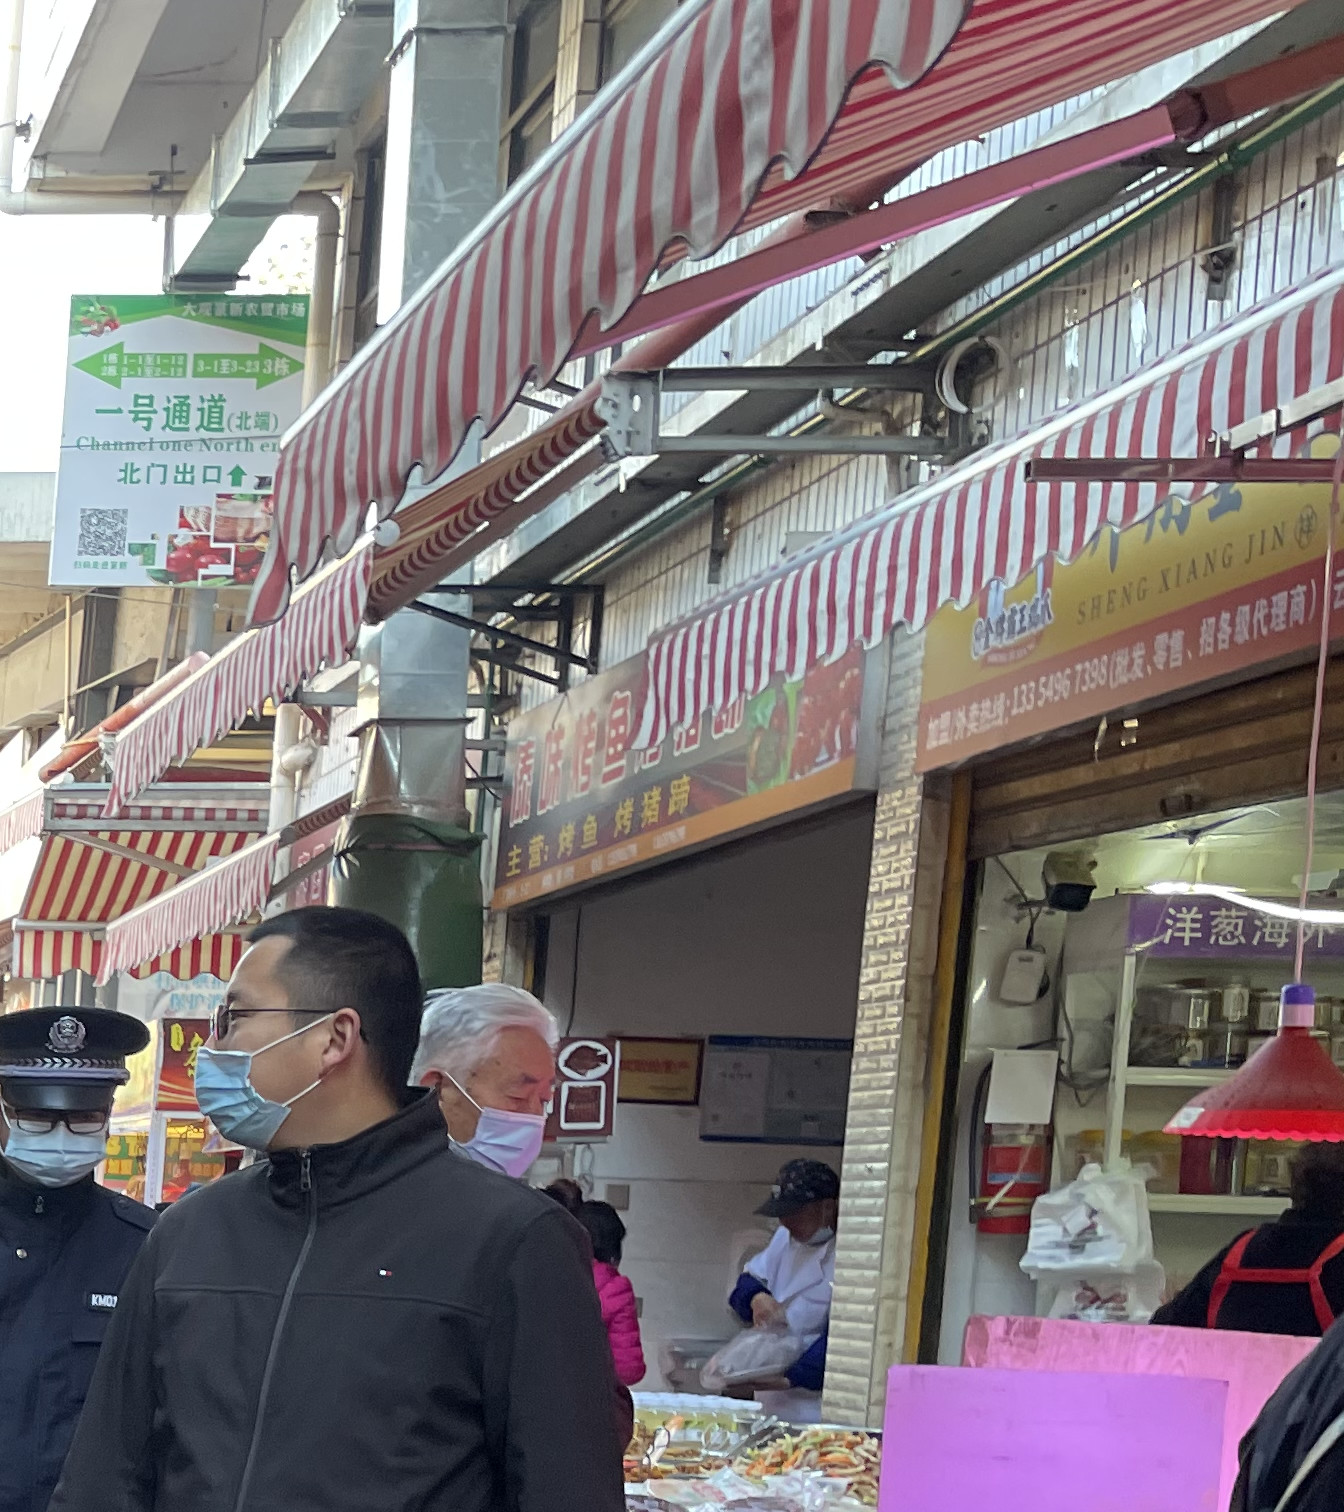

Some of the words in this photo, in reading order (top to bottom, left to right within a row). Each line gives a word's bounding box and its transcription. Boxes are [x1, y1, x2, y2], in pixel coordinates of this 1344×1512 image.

[76, 436, 155, 453] Channel
[160, 440, 193, 453] one
[199, 436, 255, 453] North
[117, 461, 223, 486] 北门出口
[1076, 577, 1148, 626] SHENG
[1158, 542, 1233, 594] XIANG
[1244, 521, 1285, 564] JIN
[1037, 667, 1071, 708] 5496
